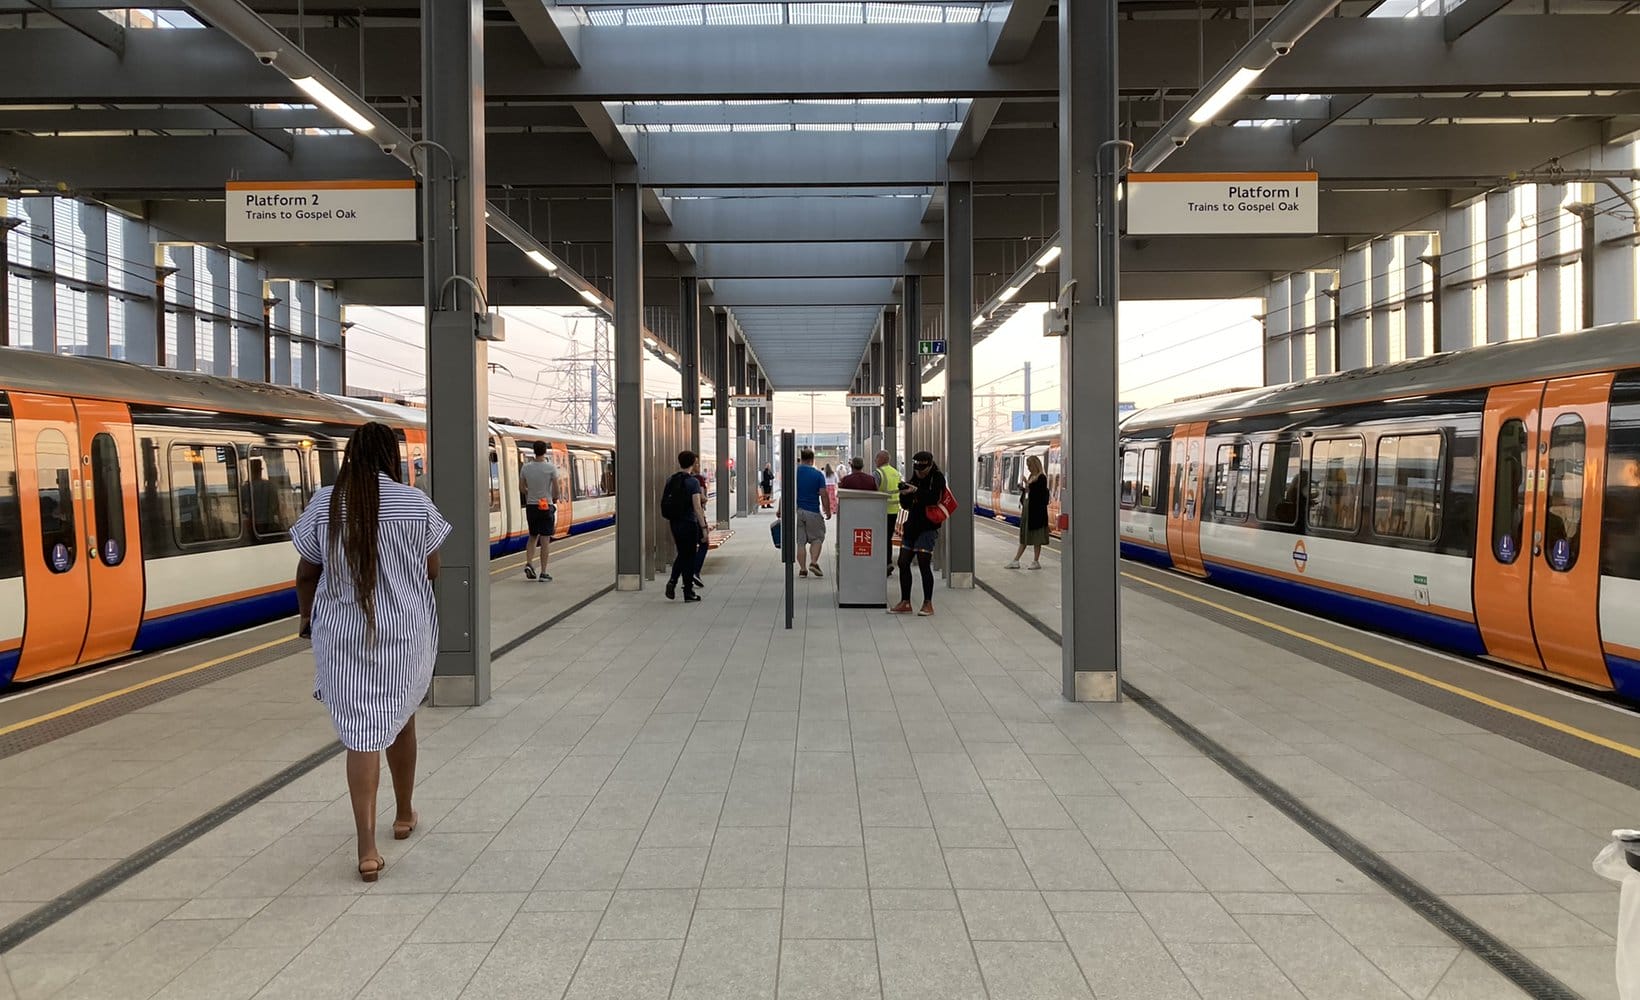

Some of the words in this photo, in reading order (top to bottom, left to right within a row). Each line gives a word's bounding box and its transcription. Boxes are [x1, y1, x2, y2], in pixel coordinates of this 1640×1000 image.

[1228, 186, 1290, 199] Platform
[246, 194, 307, 206] Platform
[311, 194, 319, 206] 2
[1187, 202, 1219, 212] Trains
[1222, 202, 1235, 212] to
[1237, 202, 1275, 214] Gospel
[1278, 202, 1299, 212] Oak
[246, 210, 277, 219] Trains
[280, 210, 292, 219] to
[295, 209, 332, 220] Gospel
[336, 209, 356, 219] Oak
[854, 530, 864, 543] H
